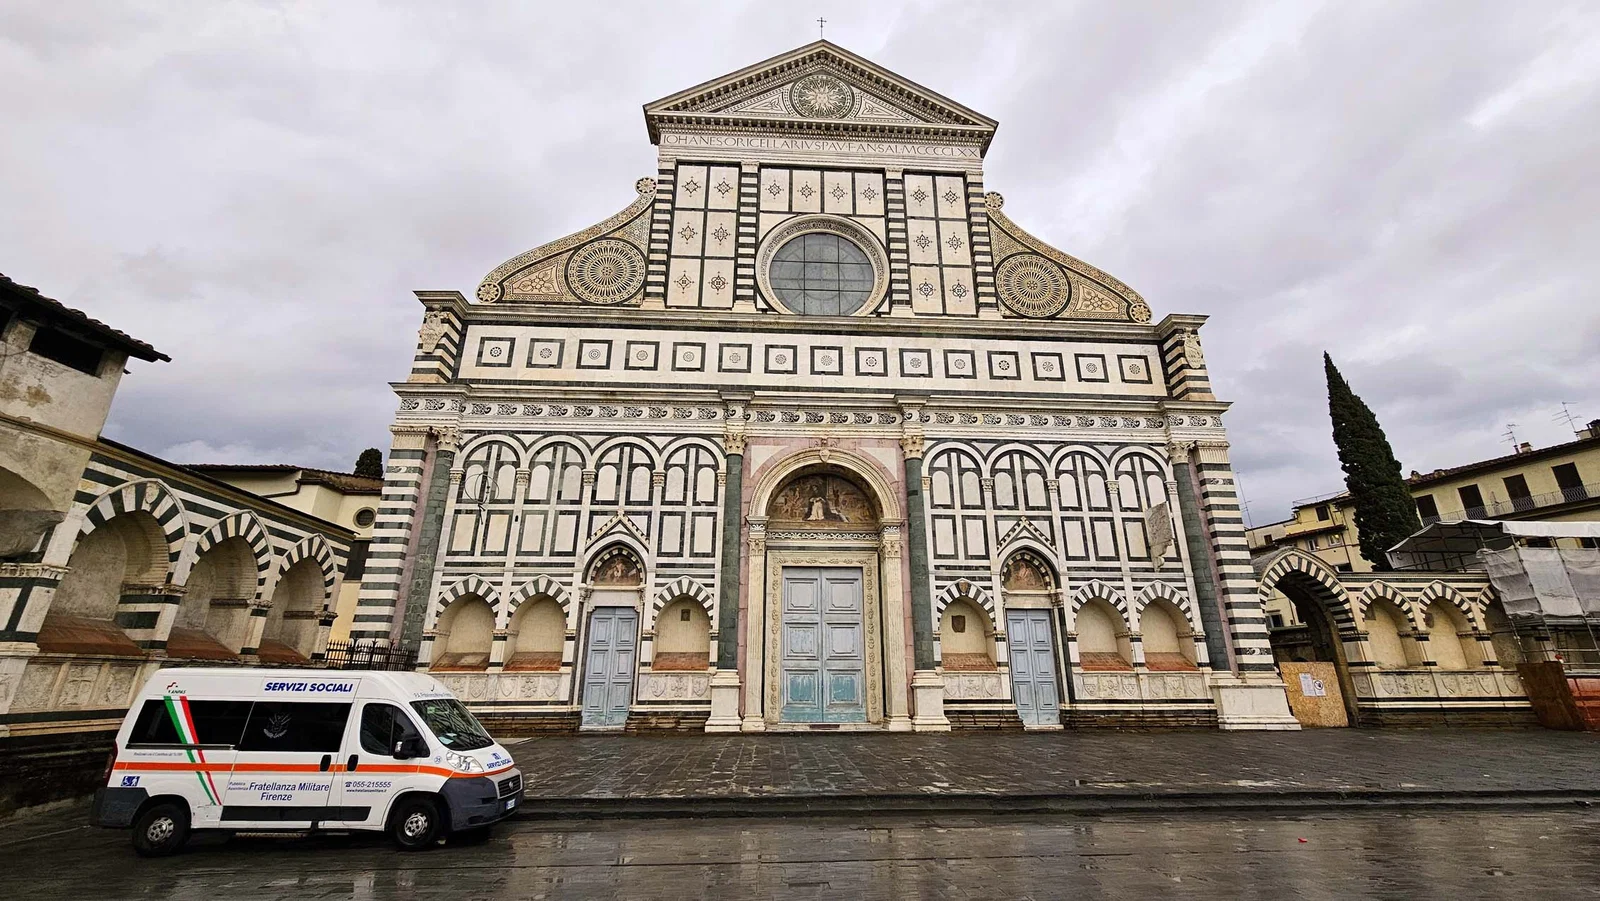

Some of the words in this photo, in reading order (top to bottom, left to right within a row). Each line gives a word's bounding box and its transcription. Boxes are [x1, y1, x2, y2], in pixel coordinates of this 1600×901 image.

[264, 682, 308, 693] SERVIZI
[309, 683, 354, 693] SOCIALI
[248, 782, 297, 792] Fratellanza
[297, 782, 330, 792] Militare
[260, 791, 293, 802] Firenze
